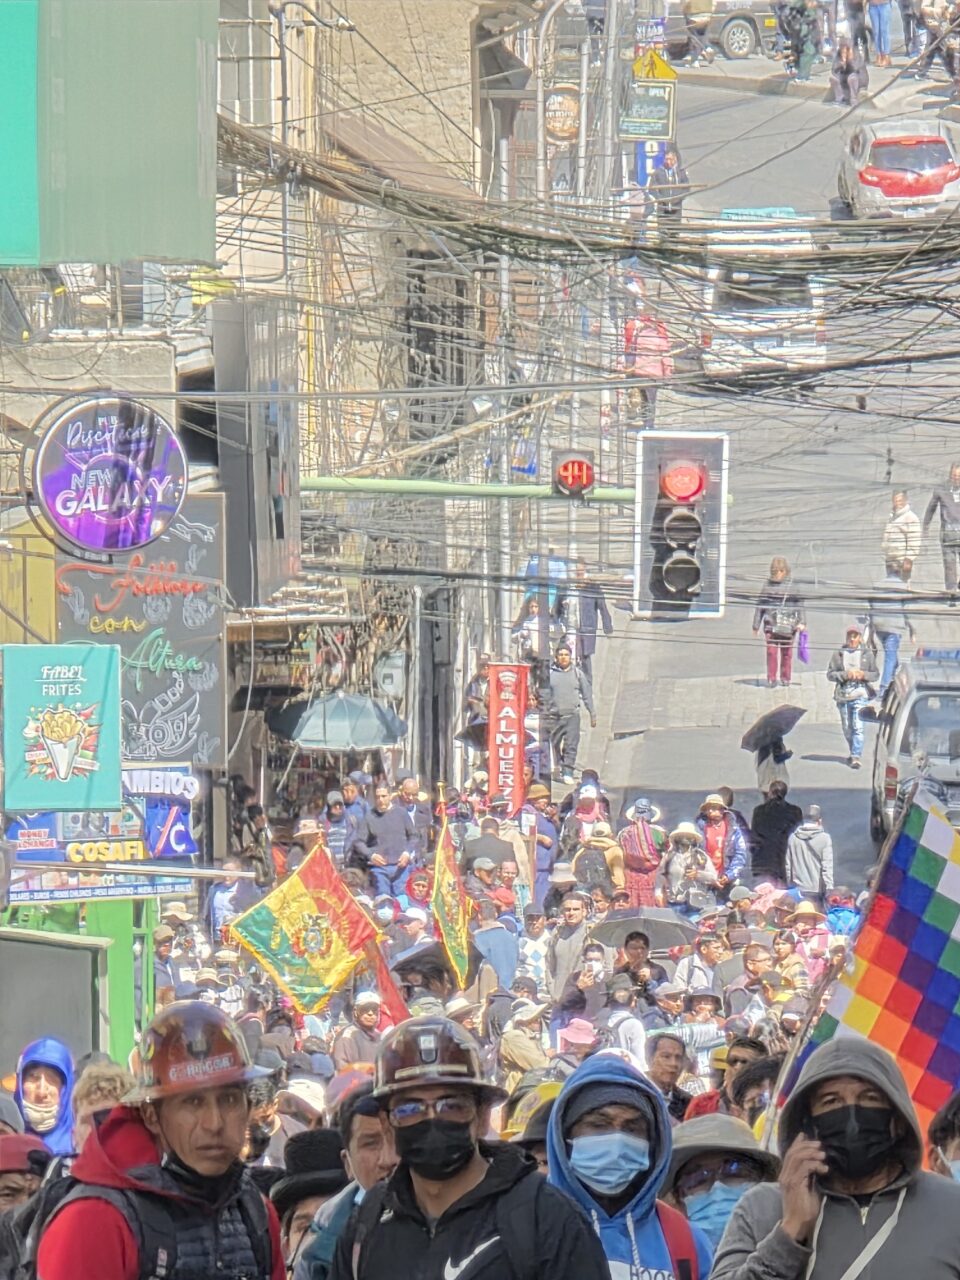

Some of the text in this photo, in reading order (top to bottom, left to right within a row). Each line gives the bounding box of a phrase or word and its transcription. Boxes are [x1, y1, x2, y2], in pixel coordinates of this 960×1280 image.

[70, 469, 112, 490] NEW
[560, 462, 587, 485] 44
[55, 475, 172, 516] GALAXY
[89, 615, 147, 634] con
[41, 664, 83, 680] FABEL
[42, 684, 82, 696] FRITES
[121, 770, 199, 799] AMBIOS
[67, 841, 144, 863] COSAFI
